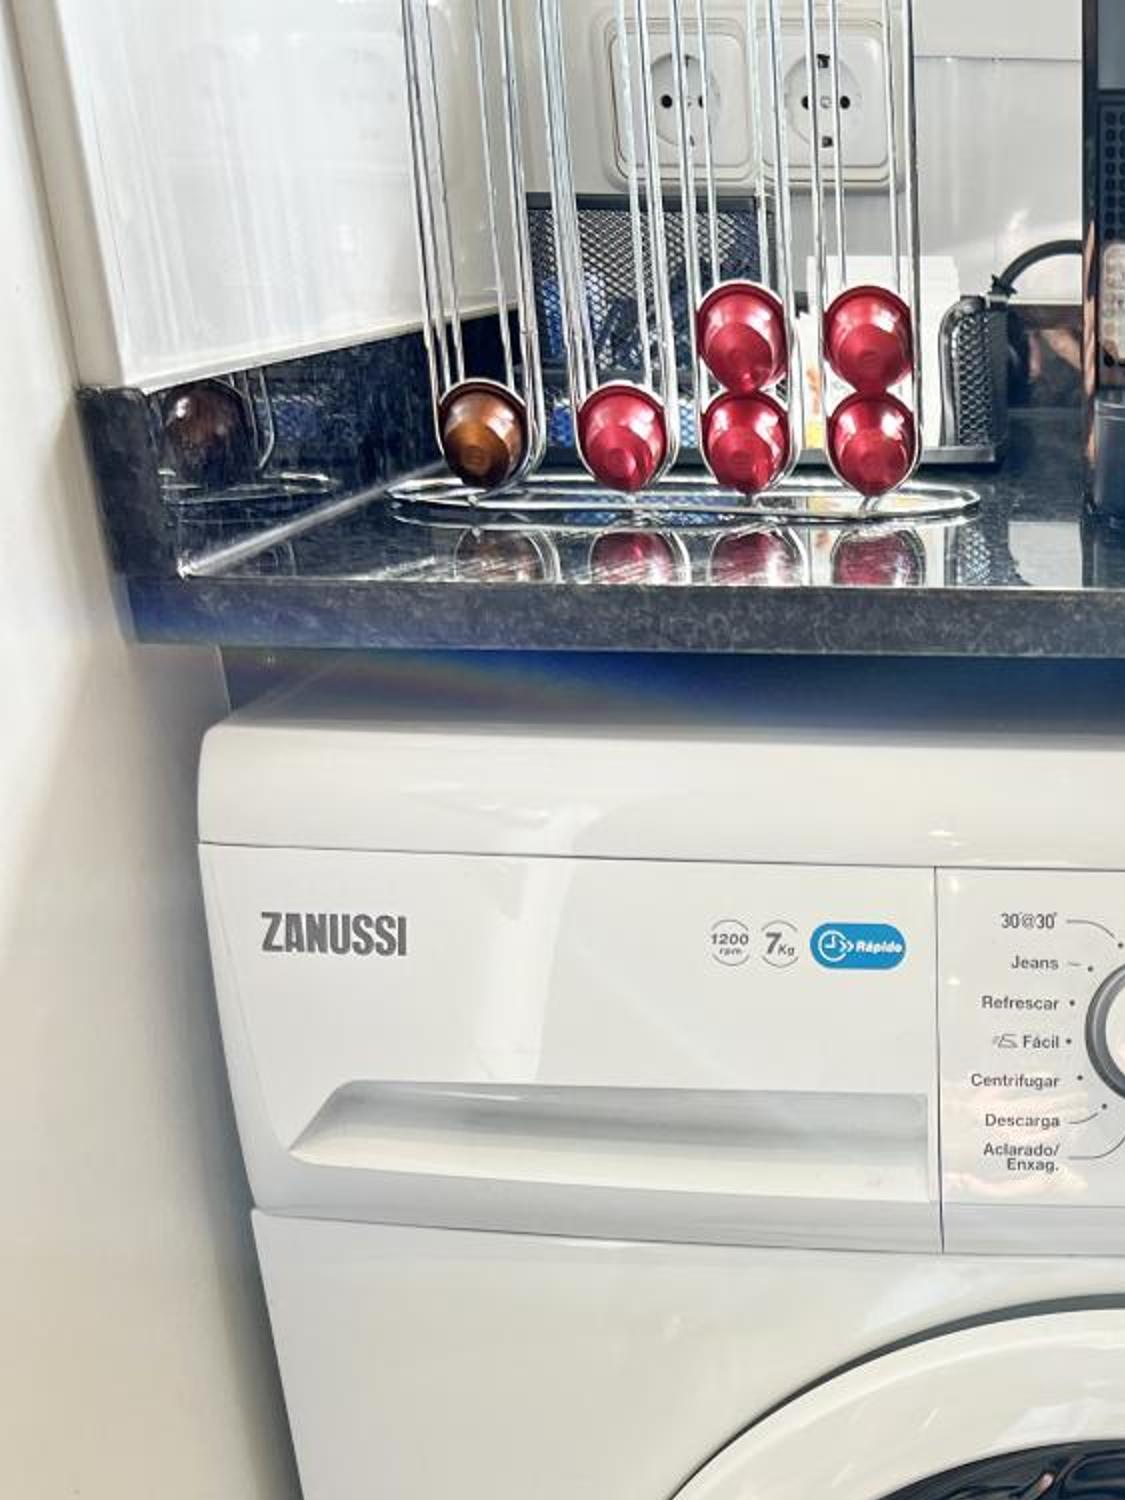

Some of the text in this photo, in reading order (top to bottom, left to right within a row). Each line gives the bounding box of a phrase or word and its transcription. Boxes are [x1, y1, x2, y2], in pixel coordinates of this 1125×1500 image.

[261, 911, 407, 956] ZANUSSI
[711, 932, 749, 945] 1200
[719, 947, 742, 956] rpm
[855, 940, 903, 954] Rápido
[1011, 955, 1059, 970] Jeans
[981, 995, 1060, 1010] Refrescar
[1023, 1034, 1060, 1049] Fácil
[970, 1073, 1060, 1090] Centrifugar
[985, 1113, 1061, 1131] Descarga
[983, 1142, 1061, 1157] Aclarado/
[1006, 1158, 1060, 1174] Enxag.
